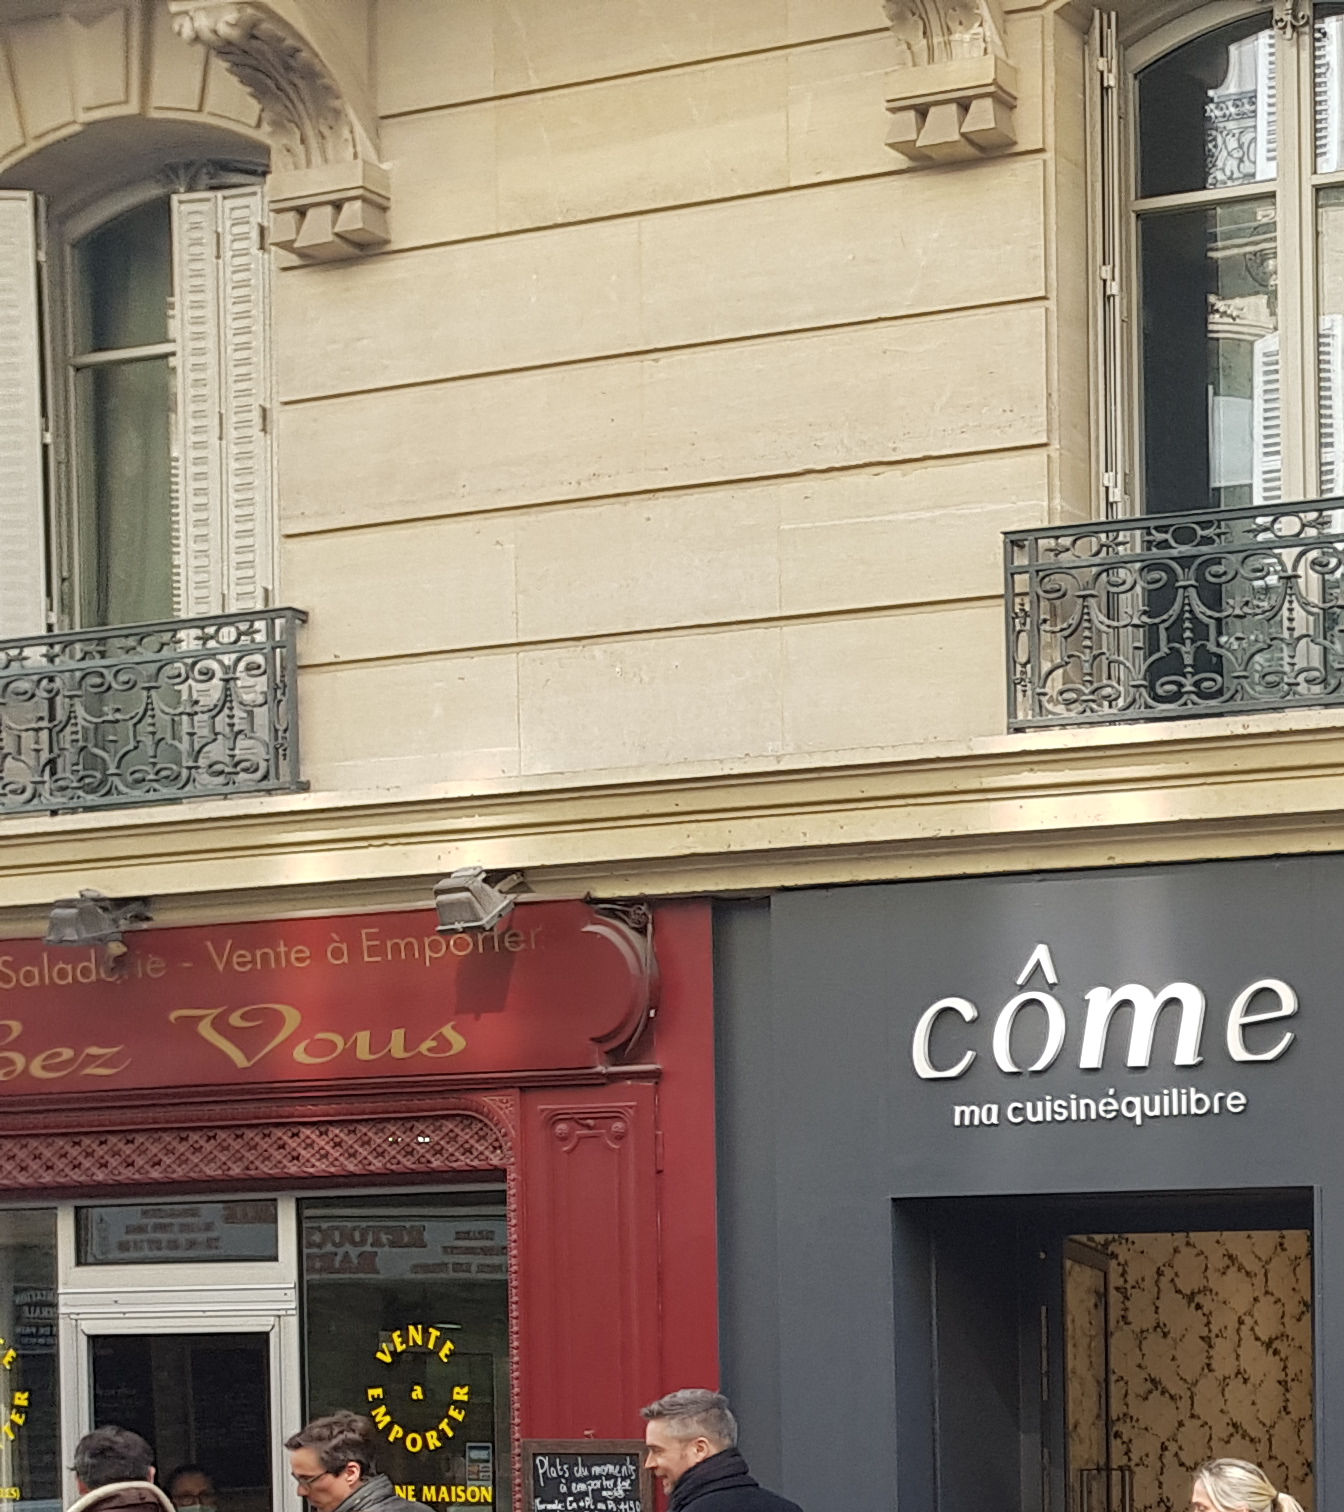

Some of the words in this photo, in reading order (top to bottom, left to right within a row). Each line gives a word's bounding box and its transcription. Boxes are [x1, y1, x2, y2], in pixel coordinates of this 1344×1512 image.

[206, 939, 310, 973] Vente
[327, 933, 348, 965] à
[912, 943, 1299, 1079] côme
[169, 1003, 467, 1069] Vous
[954, 1102, 999, 1126] ma
[1007, 1087, 1247, 1126] cuisinéquilibre
[375, 1324, 455, 1364] VENTE
[411, 1385, 424, 1400] a
[367, 1385, 469, 1453] EMPORTER
[536, 1456, 569, 1487] Plats
[573, 1456, 589, 1478] du
[422, 1485, 493, 1503] MAISON
